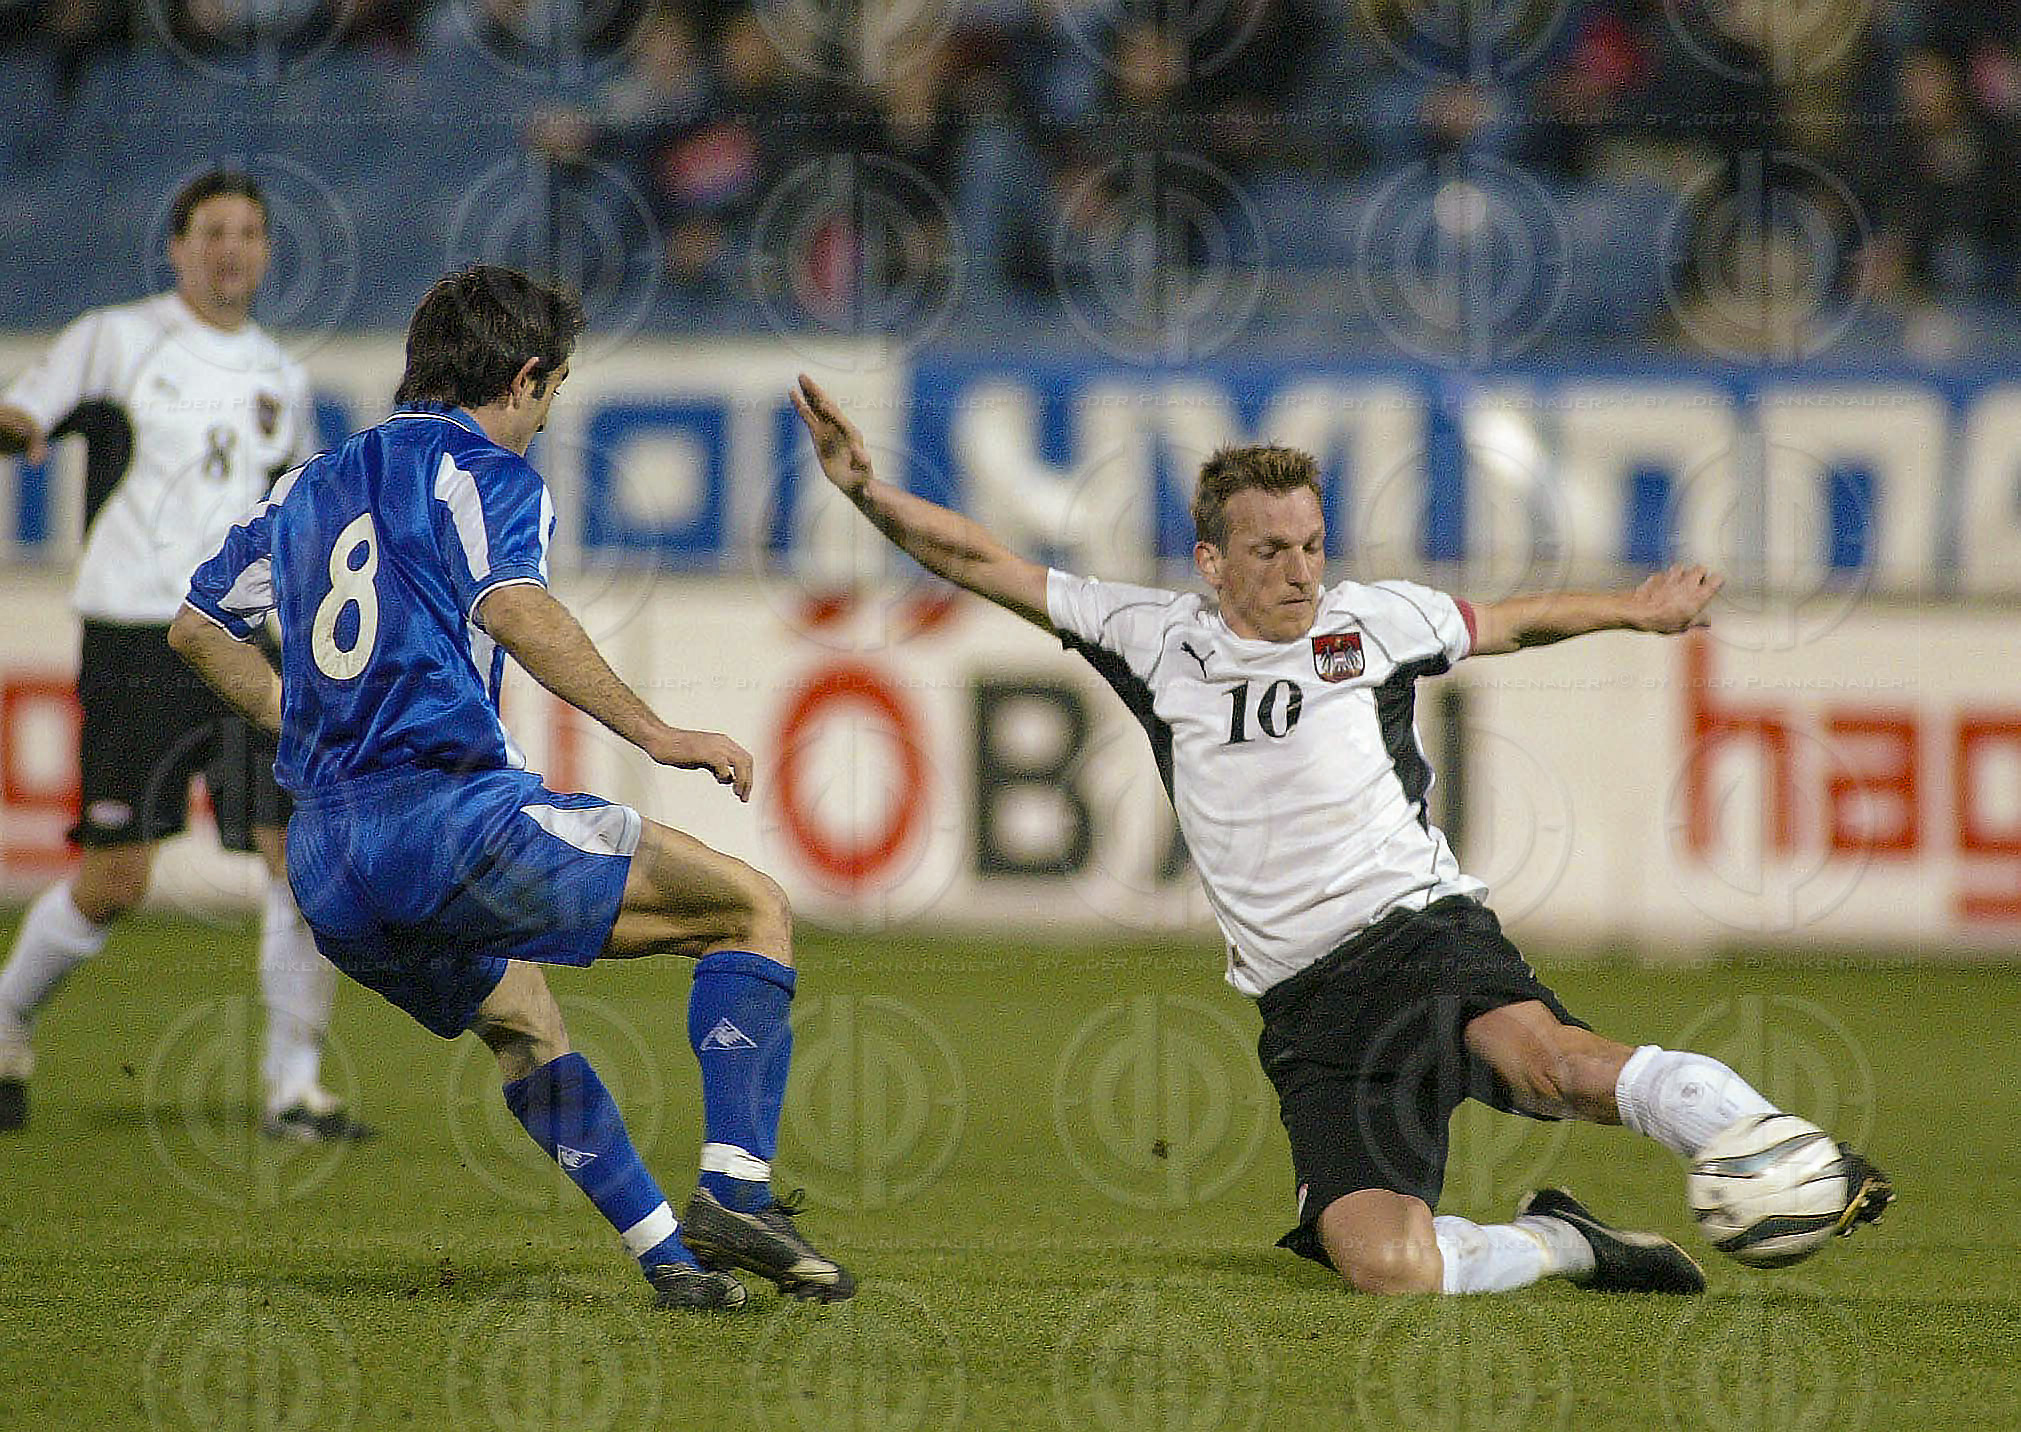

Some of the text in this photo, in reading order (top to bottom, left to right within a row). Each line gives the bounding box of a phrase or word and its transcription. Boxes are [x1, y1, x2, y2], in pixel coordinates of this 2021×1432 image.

[203, 427, 237, 482] 8
[312, 513, 378, 680] 8
[1220, 679, 1304, 745] 10
